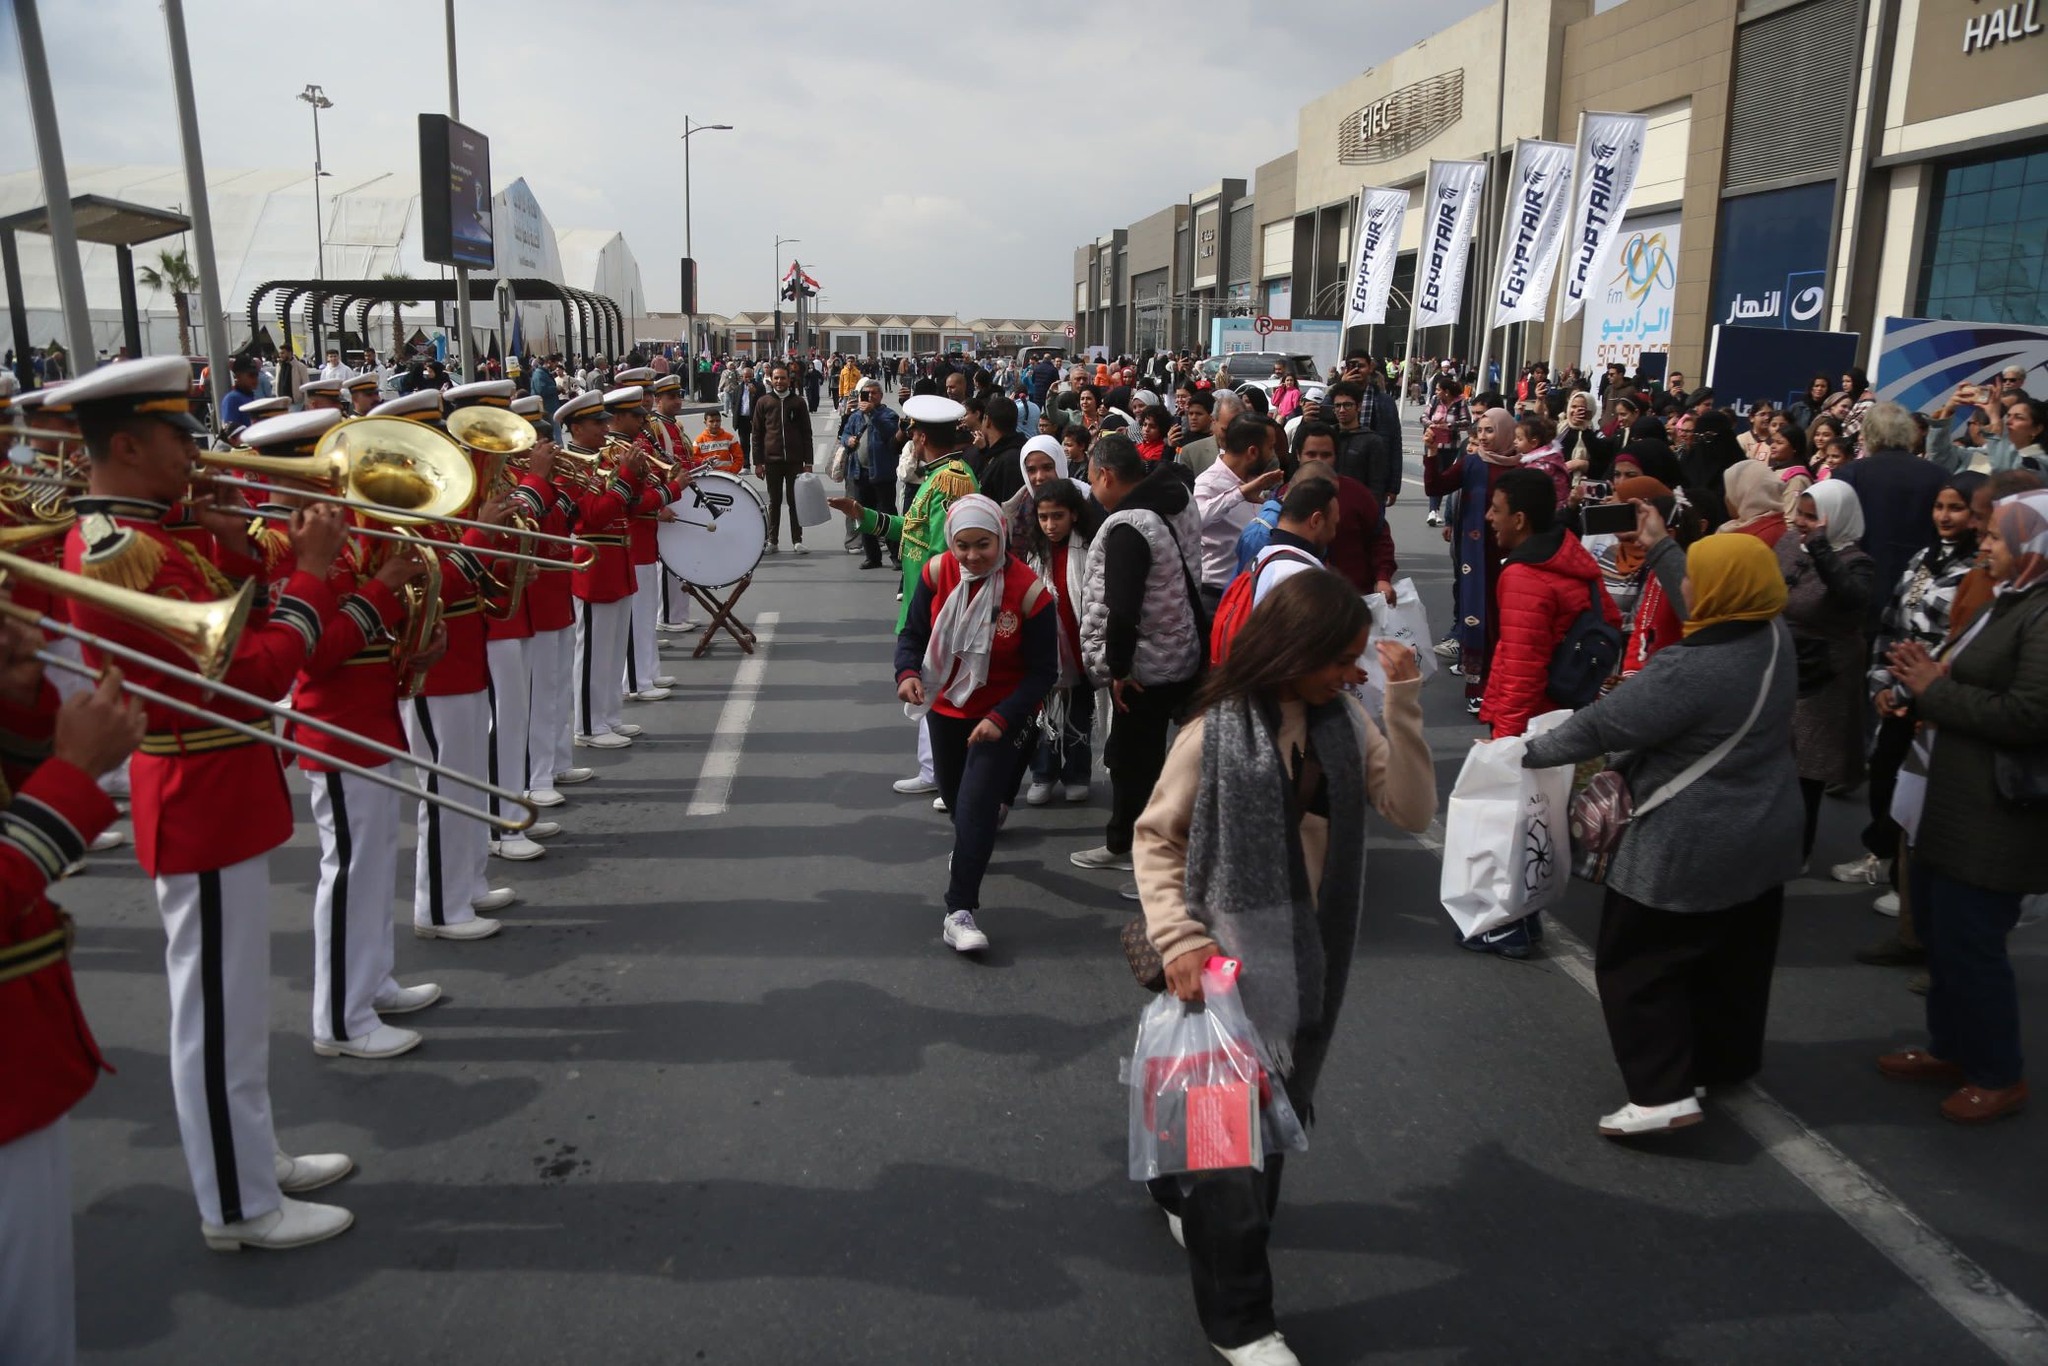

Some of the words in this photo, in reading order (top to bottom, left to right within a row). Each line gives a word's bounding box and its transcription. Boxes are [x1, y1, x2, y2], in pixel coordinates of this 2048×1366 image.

[1962, 0, 2040, 52] HALL
[1360, 98, 1392, 140] EIEC
[1351, 221, 1383, 314] EGYPTAIR
[1420, 202, 1457, 313] EGYPTAIR
[1499, 187, 1544, 309] EGYPTAIR
[1601, 306, 1670, 341] الراديو
[1725, 290, 1782, 325] النهار
